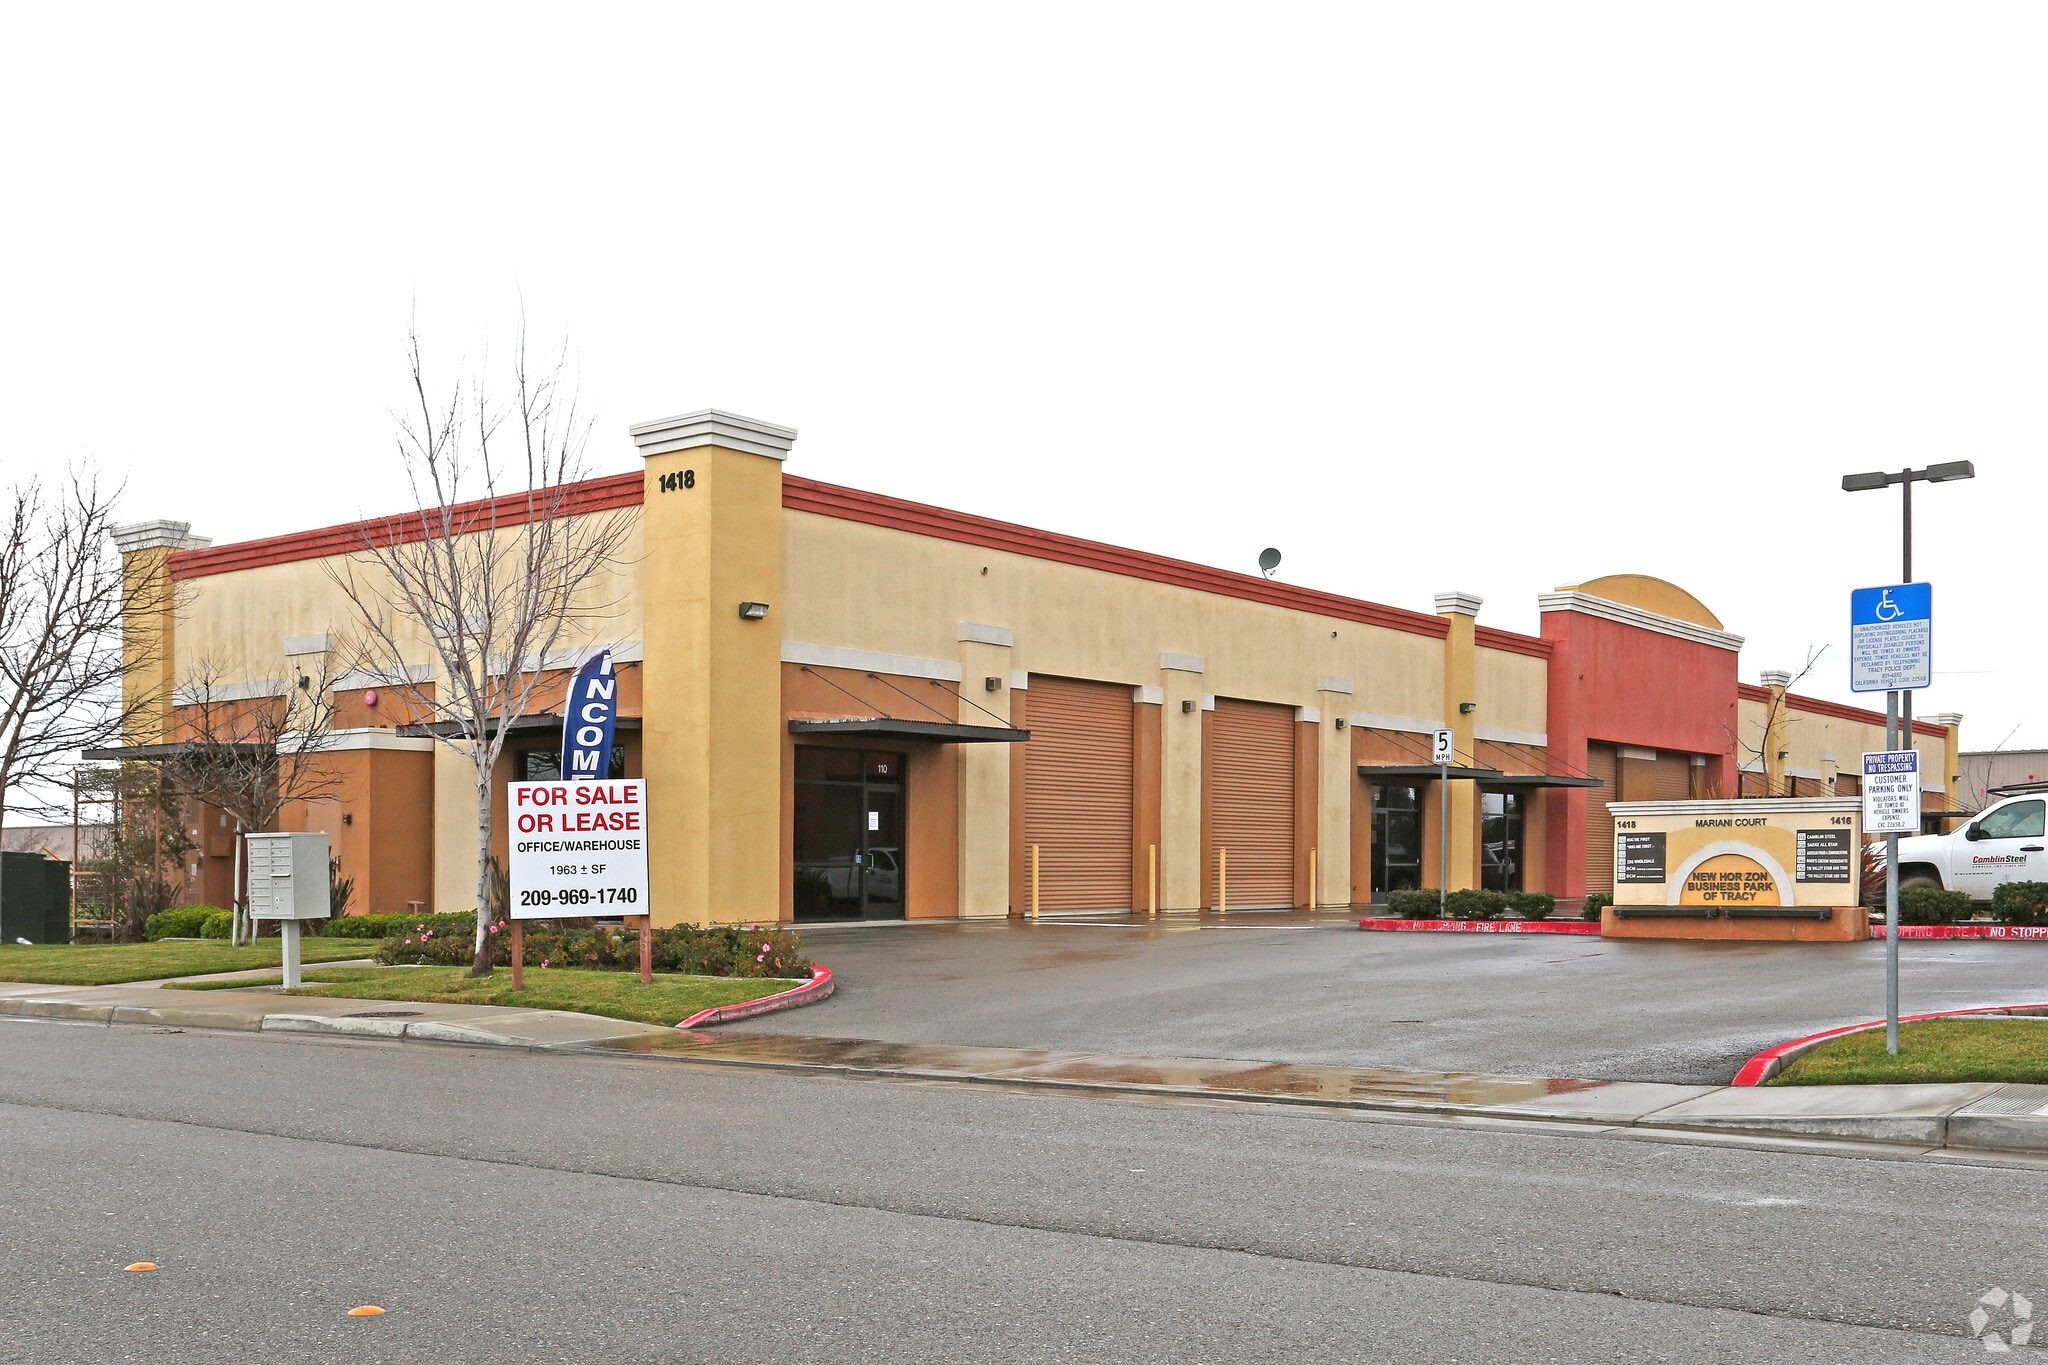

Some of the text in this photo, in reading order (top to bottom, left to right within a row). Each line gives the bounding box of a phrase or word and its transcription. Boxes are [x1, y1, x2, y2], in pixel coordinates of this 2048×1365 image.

[659, 470, 695, 493] 1418
[572, 654, 614, 780] INCOM
[1439, 732, 1447, 751] 5
[1866, 753, 1914, 764] PRIVATE PROPERTY
[878, 765, 887, 773] 110
[1869, 763, 1912, 773] NO TRESPASSING
[1875, 775, 1907, 784] CUSTOMER
[1869, 784, 1913, 794] PARKING ONLY
[518, 786, 638, 806] FOR SALE
[518, 812, 640, 833] OR LEASE
[1735, 818, 1767, 826] COURT
[517, 840, 640, 853] OFFICE/WAREHOUSE
[550, 865, 577, 875] 1963
[591, 864, 606, 874] SF
[1692, 872, 1717, 881] NEW
[1688, 882, 1773, 891] BUSINESS PARK
[520, 888, 637, 906] 209-969-1740
[1703, 892, 1756, 900] OF TRACY
[1476, 923, 1495, 932] FIRE
[1499, 922, 1521, 932] LANE
[1990, 927, 2005, 937] NO
[2011, 927, 2048, 938] STOPP
